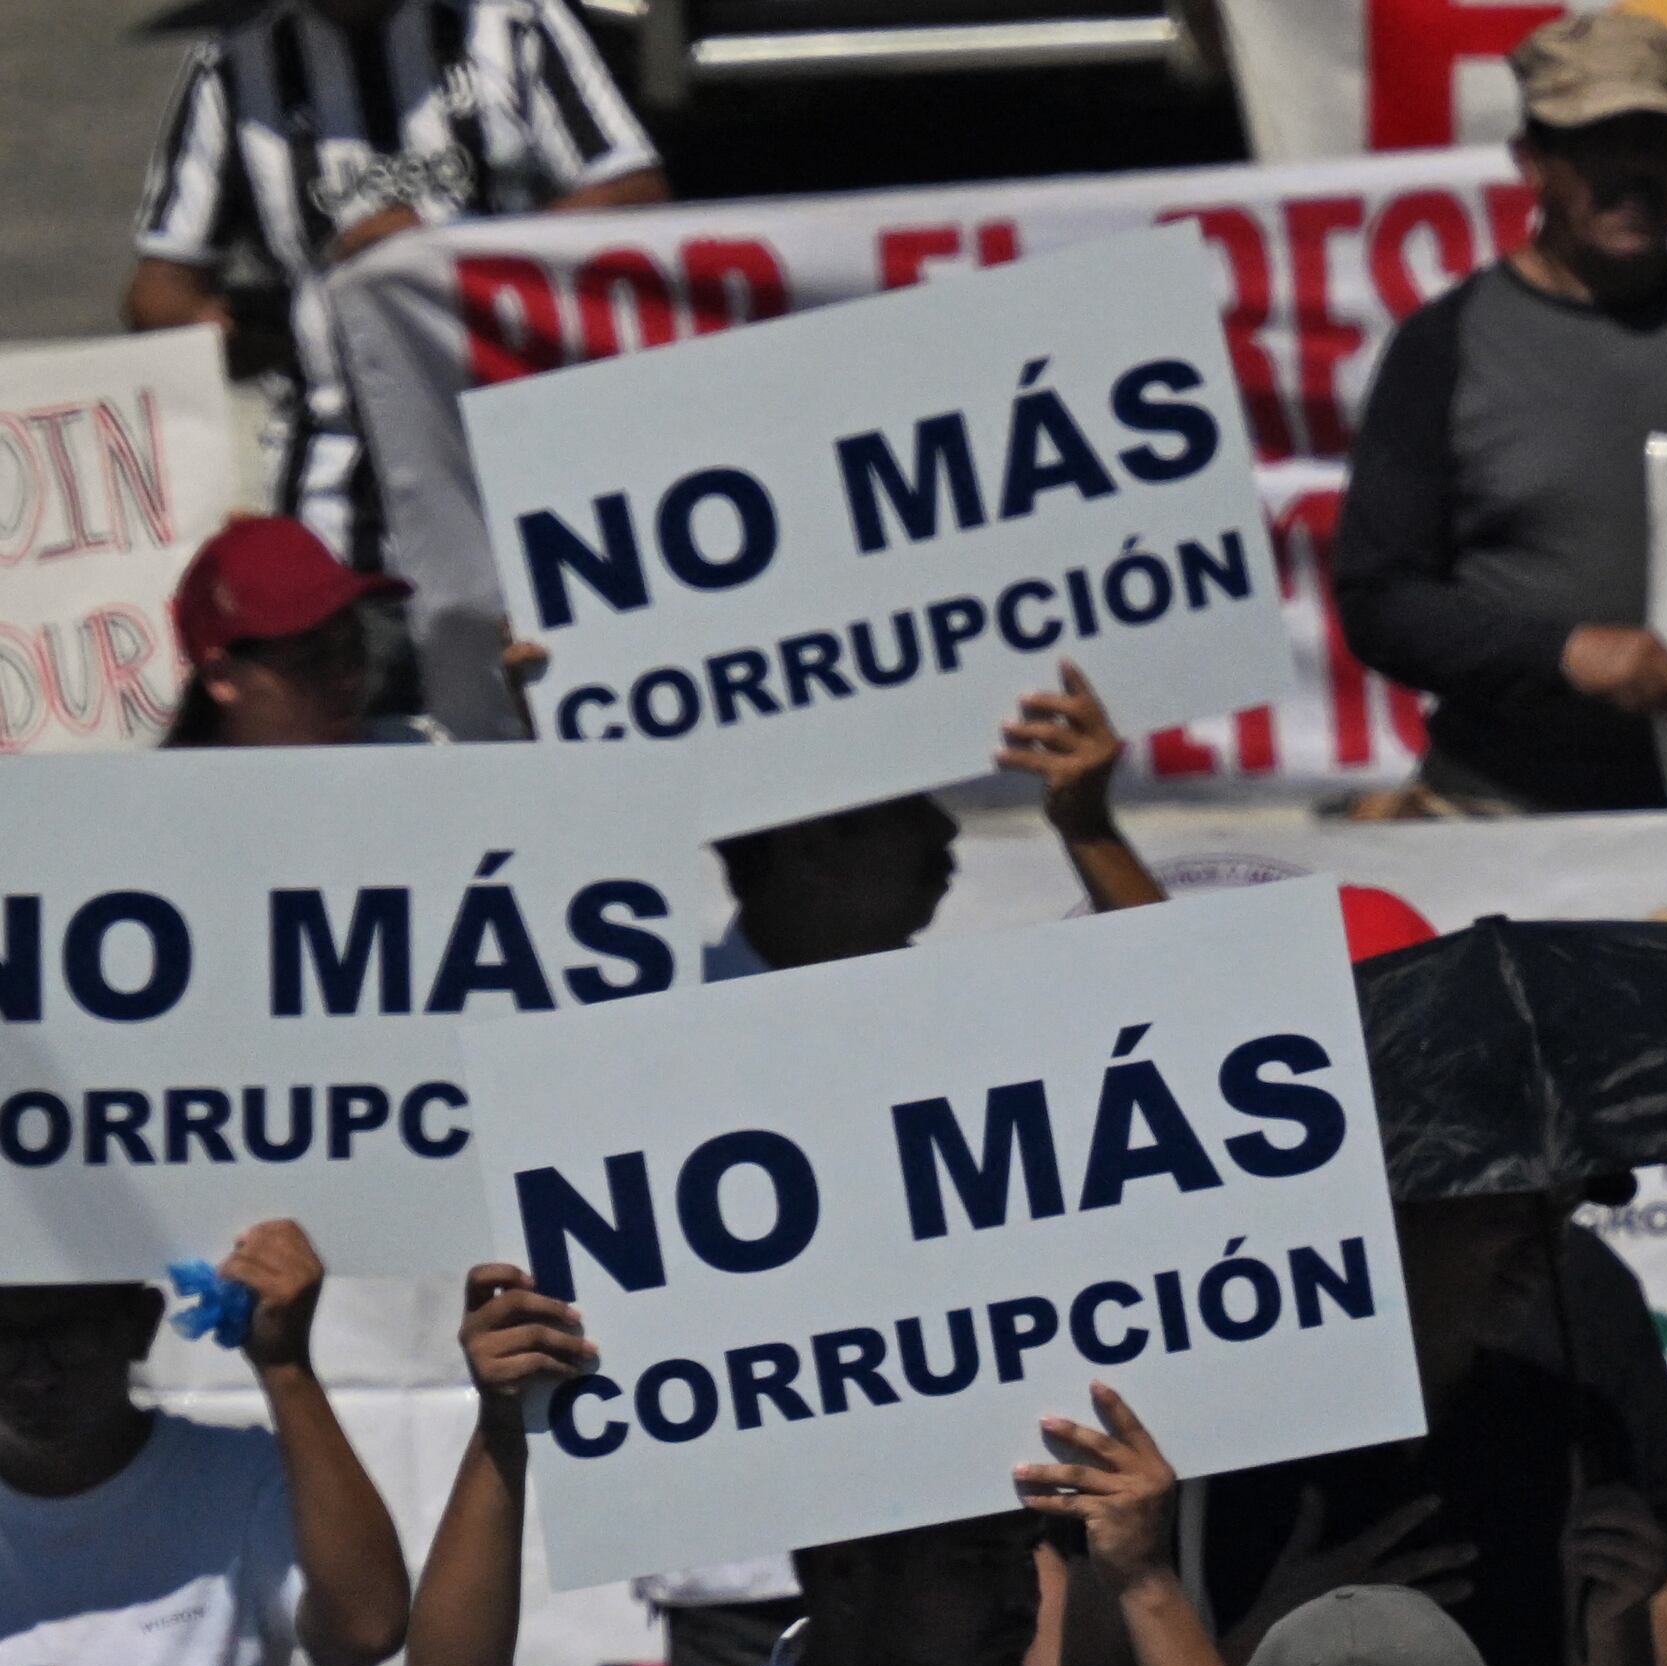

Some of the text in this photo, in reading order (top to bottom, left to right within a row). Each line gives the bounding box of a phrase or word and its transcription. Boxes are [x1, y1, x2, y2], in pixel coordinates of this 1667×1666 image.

[517, 354, 1222, 631] NO MÁS
[556, 527, 1252, 742] CORRUPCIÓN
[268, 850, 676, 1018] MÁS
[513, 1022, 1347, 1303] NO MÁS
[546, 1236, 1376, 1460] CORRUPCIÓN
